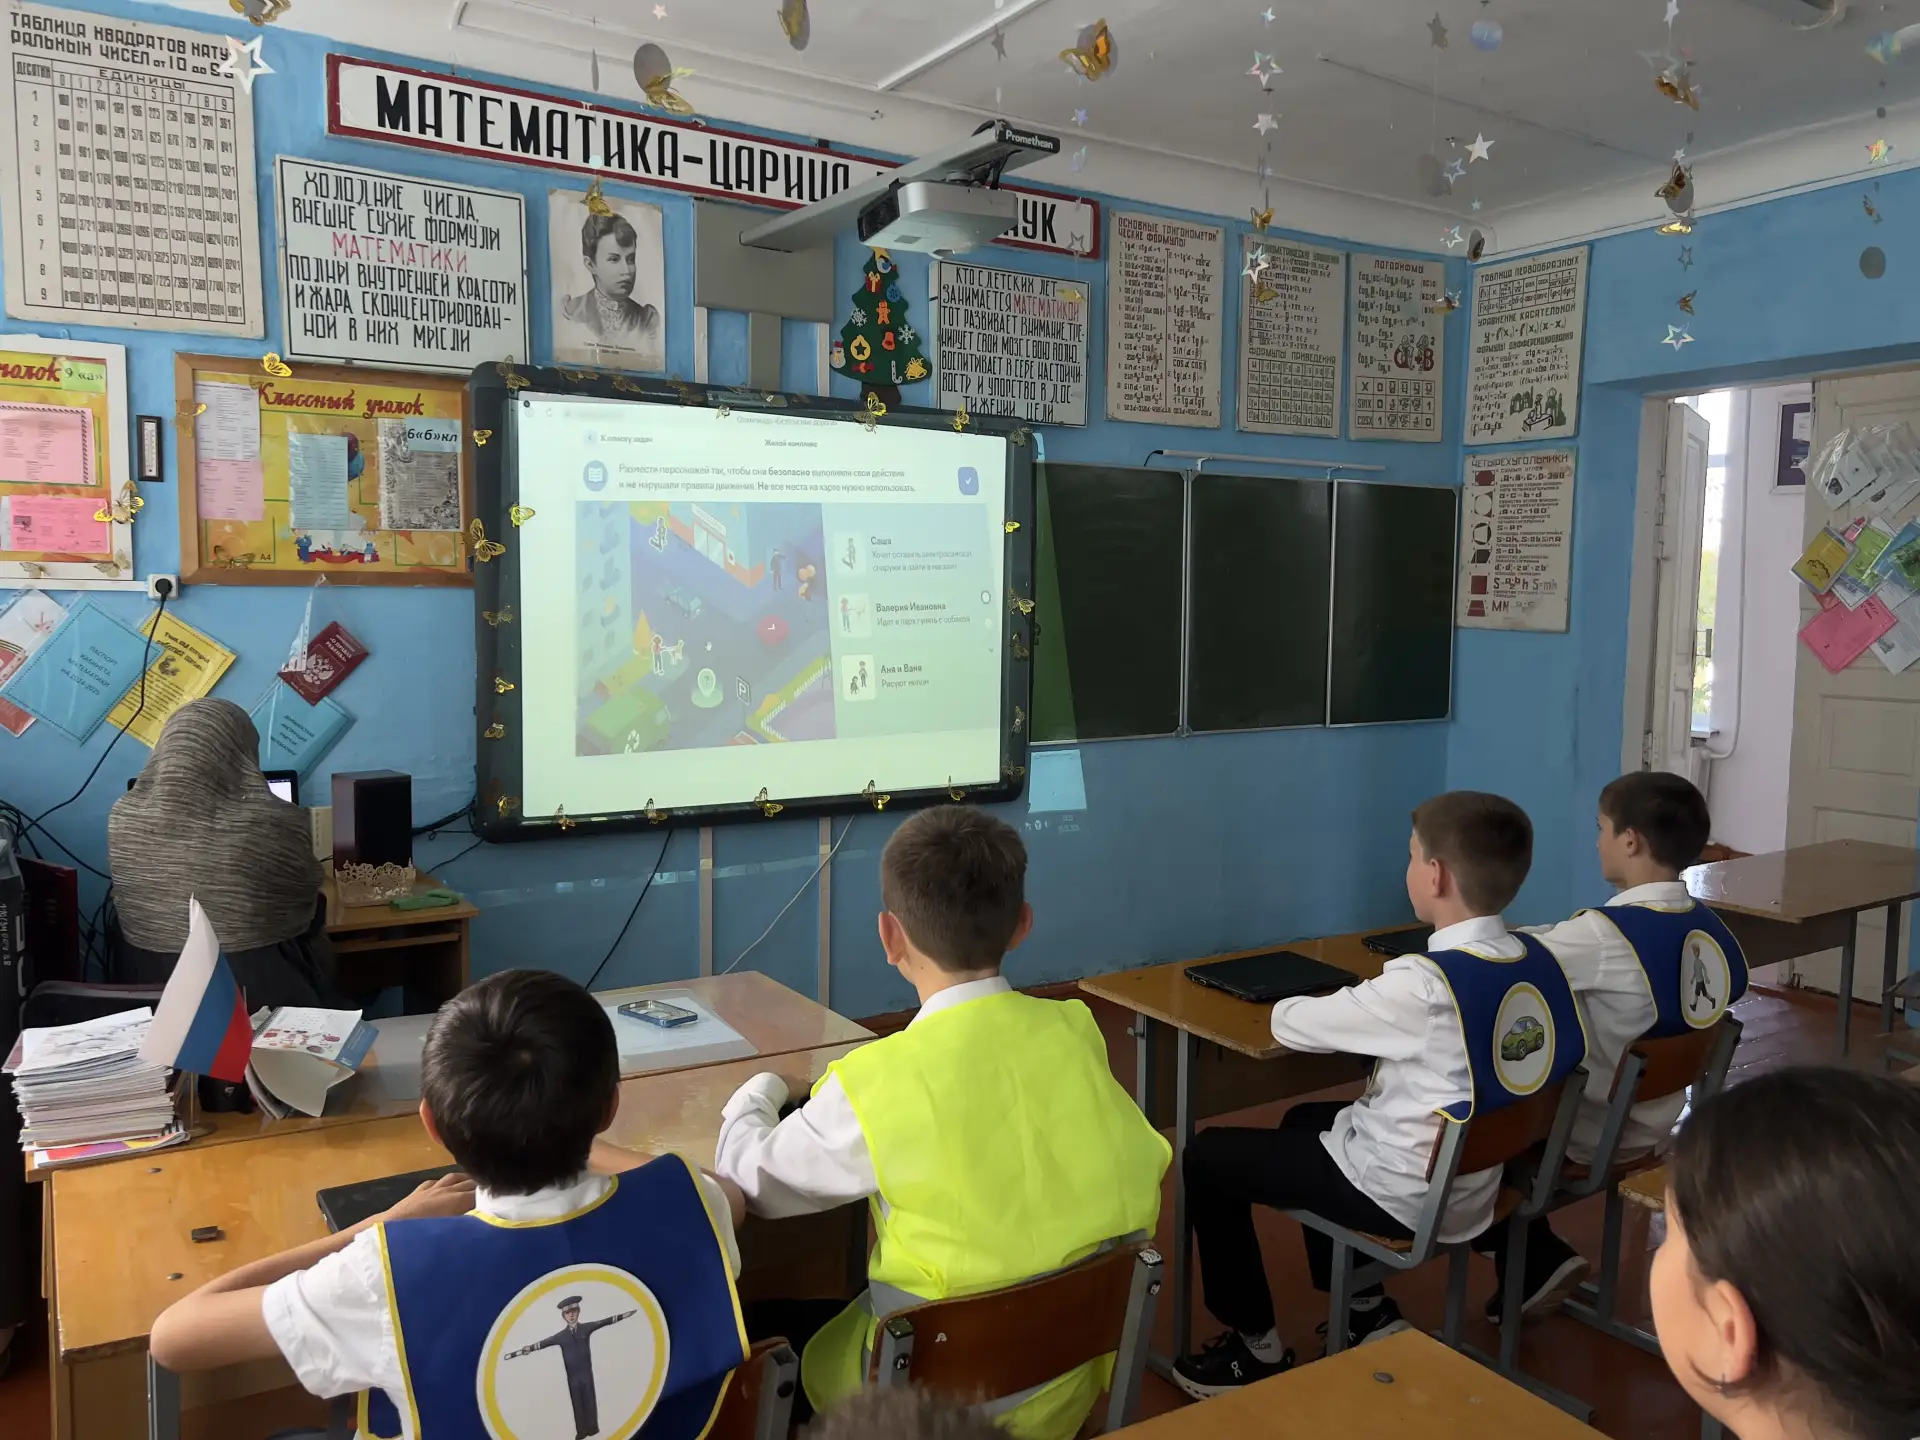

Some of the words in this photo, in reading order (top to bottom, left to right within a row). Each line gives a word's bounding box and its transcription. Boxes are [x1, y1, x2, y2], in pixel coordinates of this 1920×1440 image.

[10, 12, 86, 38] ТАБЛИЦА
[94, 25, 186, 54] КВАДРАТОВ
[191, 42, 231, 61] НАТУ
[11, 29, 92, 56] РАЛЬНЫХ
[99, 44, 150, 66] ЧИСЕЛ
[168, 55, 187, 71] 10
[99, 69, 186, 90] ЕДИНИЦЫ
[32, 90, 37, 101] 1
[97, 80, 102, 92] 2
[115, 82, 120, 95] 3
[133, 85, 139, 97] 4
[151, 88, 157, 100] 5
[169, 91, 175, 103] 6
[187, 93, 192, 104] 7
[204, 96, 210, 107] 8
[222, 98, 227, 110] 9
[32, 114, 38, 127] 2
[34, 139, 40, 152] 3
[1005, 129, 1053, 149] Promethean
[36, 189, 42, 202] 5
[304, 171, 404, 210] ХОЛОДНЫЕ
[424, 189, 479, 223] ЧИСЛА,
[37, 214, 43, 226] 6
[292, 197, 357, 231] ВНЕШНЕ
[367, 205, 416, 240] СУХИЕ
[425, 216, 500, 251] ФОРМУЛЫ
[1118, 217, 1158, 233] ОСНОВНЫЕ
[39, 239, 44, 250] 7
[1118, 227, 1143, 240] ЧЕСКИЕ
[1146, 233, 1186, 247] ФОРМУЛЫ
[333, 231, 468, 273] МАТЕМАТИКИ
[40, 263, 45, 275] 8
[1374, 260, 1424, 274] ЛОГАРИФМЫ
[1481, 269, 1512, 283] ТАБЛИЦА
[1515, 256, 1579, 277] ПЕРВООБРАЗНЫХ
[289, 254, 349, 285] ПОЛНЫ
[357, 263, 450, 297] ВНУТРЕННЕЙ
[457, 276, 516, 305] КРАСОТЫ
[956, 266, 975, 286] КТО
[984, 271, 1034, 294] ДЕТСКИХ
[1039, 281, 1058, 297] ЛЕТ
[41, 288, 47, 300] 9
[295, 283, 305, 309] И
[309, 286, 352, 314] ЖАРА
[942, 284, 1012, 313] ЗАНИМАЕТСЯ
[1013, 294, 1080, 322] МАТЕМАТИКОЙ
[942, 305, 960, 327] ТОТ
[964, 308, 1017, 334] РАЗВИВАЕТ
[1021, 317, 1068, 342] ВНИМАНИЕ,
[1478, 313, 1516, 327] УРАВНЕНИЕ
[1520, 300, 1576, 321] КАСАТЕЛЬНОЙ
[304, 313, 337, 339] НОЙ
[349, 317, 357, 341] В
[366, 318, 399, 345] НИХ
[413, 324, 470, 352] МЫСЛИ
[941, 328, 974, 350] НИРУЕТ
[976, 332, 998, 354] СВОЙ
[1026, 338, 1050, 361] СВОЮ
[942, 350, 1002, 375] ВОСПИТЫВАЕТ
[1006, 357, 1012, 376] В
[1015, 359, 1034, 379] СЕБЕ
[1249, 347, 1286, 359] ФОРМУЛЫ
[1292, 352, 1336, 365] ПРИВЕДЕНИЯ
[65, 367, 73, 379] 9
[942, 372, 971, 394] ВОСТЬ
[977, 375, 984, 395] И
[988, 377, 1036, 401] УПОРСТВО
[1041, 382, 1047, 401] В
[257, 382, 355, 411] Классный
[362, 392, 424, 419] уголок
[619, 463, 658, 474] Размести
[660, 465, 710, 476] персонажей
[727, 466, 751, 476] чтобы
[768, 466, 811, 476] безопасно
[871, 468, 905, 478] действия
[1471, 454, 1568, 468] ЧЕТЫРЕХУГОЛЬНИКИ
[639, 482, 679, 491] нарушали
[681, 482, 714, 491] правила
[757, 482, 769, 490] Не
[871, 536, 891, 545] Саша
[876, 603, 909, 613] Валерия
[909, 602, 946, 611] Ивановна
[89, 645, 118, 666] ПАСПОРТ
[68, 657, 110, 688] МАТЕМАТИКИ
[881, 665, 896, 674] Аня
[903, 664, 922, 673] Ваня
